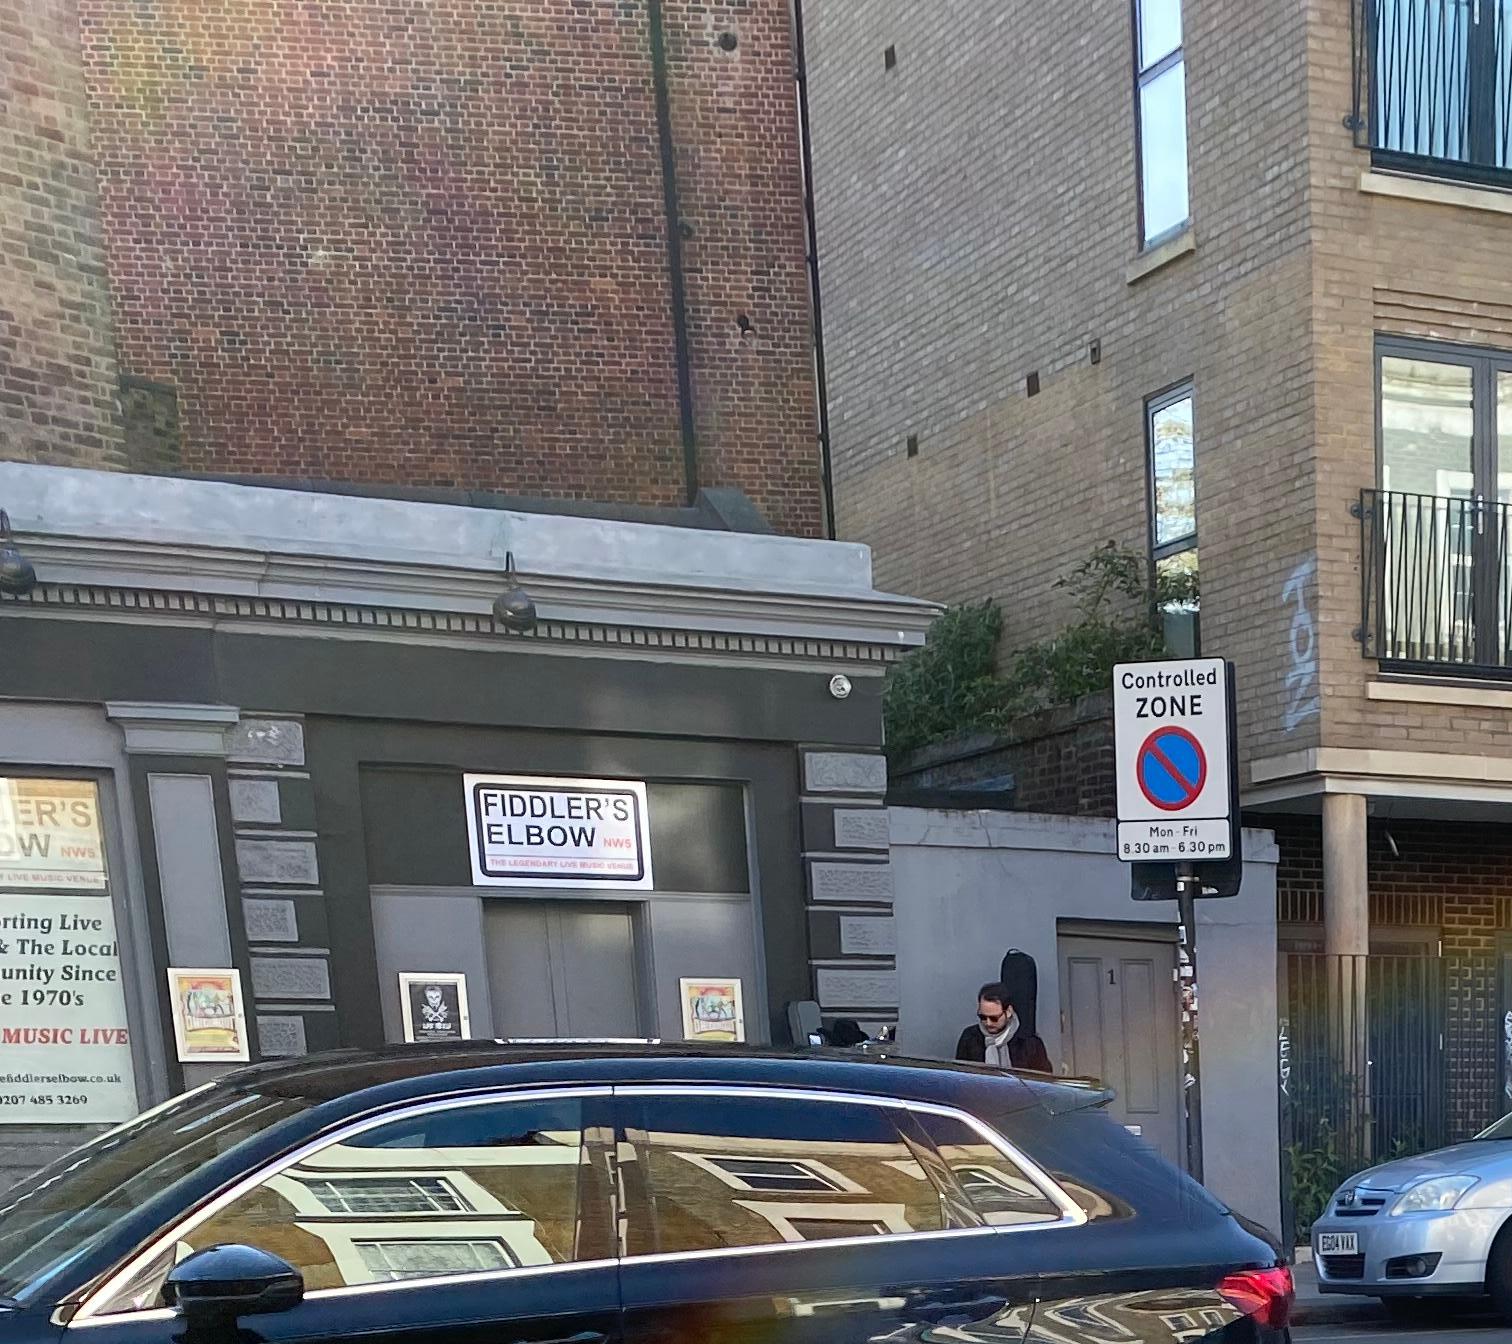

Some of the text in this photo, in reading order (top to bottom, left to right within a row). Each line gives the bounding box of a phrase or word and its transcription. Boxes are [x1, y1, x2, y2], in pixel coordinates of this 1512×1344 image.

[1121, 667, 1216, 689] Controlled
[1136, 694, 1203, 718] ZONE
[483, 793, 629, 821] FIDDLER'S
[486, 823, 632, 849] ELBOW NW5
[1149, 826, 1174, 837] Mon
[1183, 825, 1198, 837] Fri
[1153, 844, 1169, 853] am
[1208, 843, 1226, 855] pm
[0, 913, 102, 934] rting Live
[16, 938, 55, 955] The
[61, 939, 118, 957] Local
[61, 964, 117, 982] Since
[1107, 968, 1117, 985] 1
[21, 989, 84, 1006] 1970's
[2, 1028, 128, 1045] MUSIC LIVE
[30, 1095, 53, 1105] 485
[57, 1095, 88, 1105] 3269
